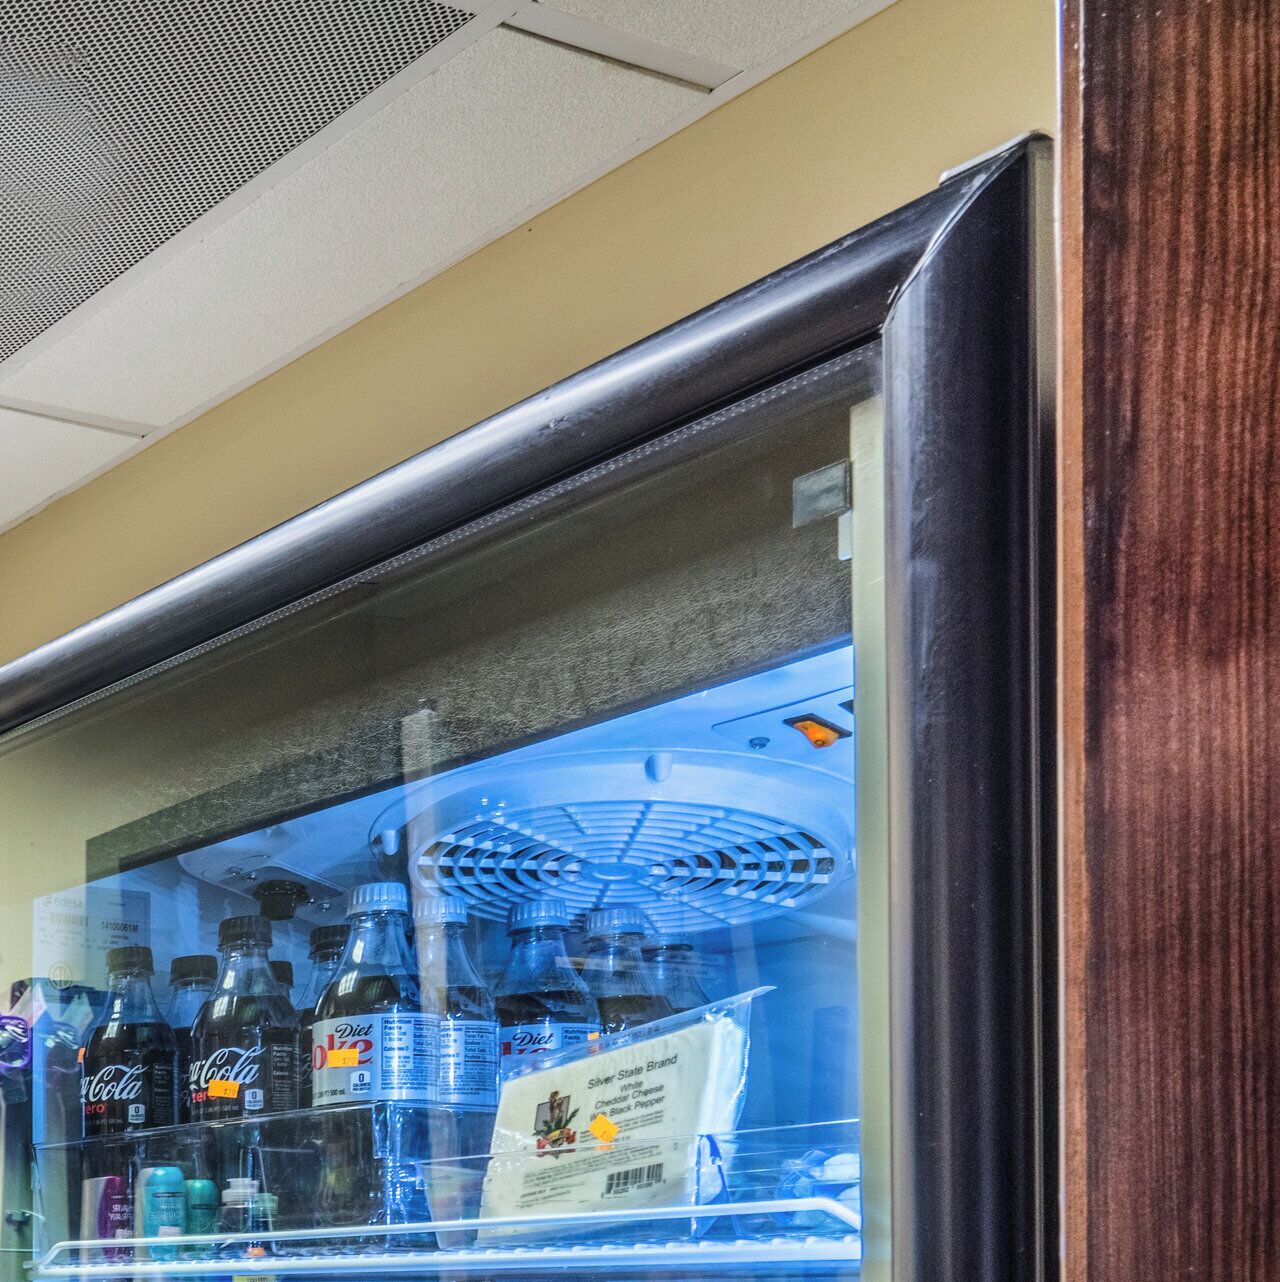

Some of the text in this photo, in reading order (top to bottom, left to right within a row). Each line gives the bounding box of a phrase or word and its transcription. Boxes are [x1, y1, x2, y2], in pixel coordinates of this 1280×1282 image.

[335, 1023, 374, 1039] Diet
[512, 1031, 555, 1046] Diet
[587, 1054, 679, 1090] Silver State Brand
[619, 1080, 644, 1093] White
[594, 1084, 665, 1110] Cheddar Cheese
[609, 1095, 666, 1117] Black Pepper
